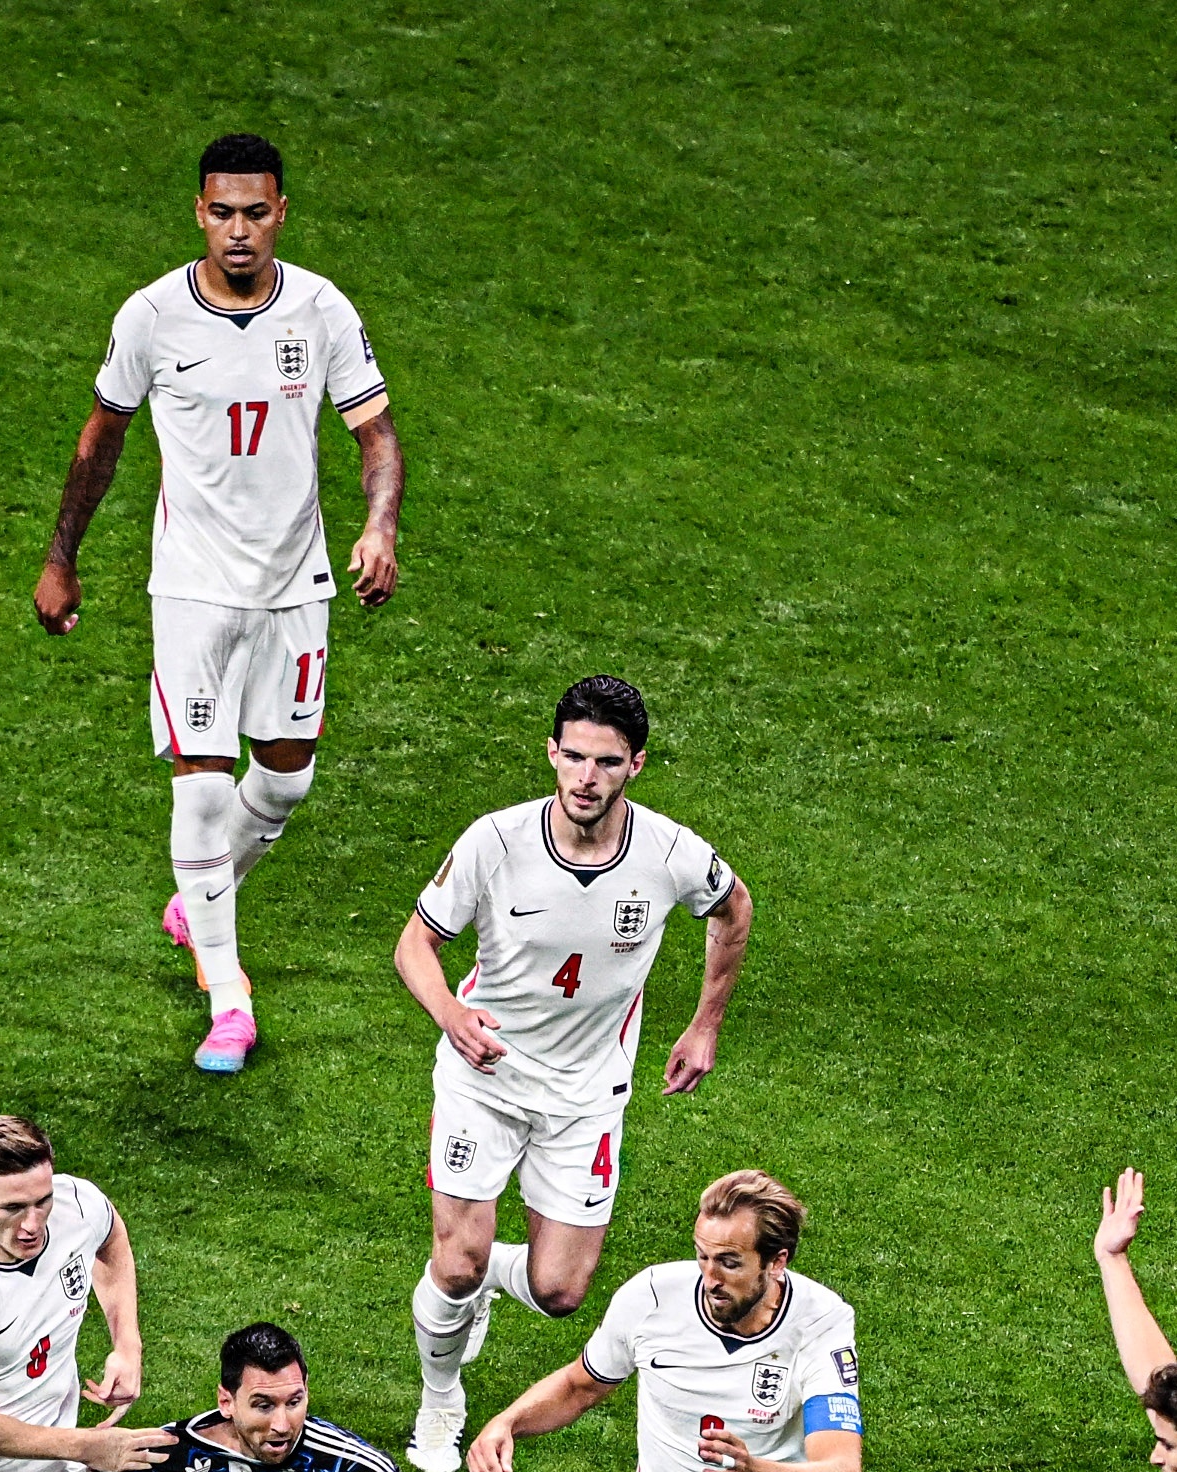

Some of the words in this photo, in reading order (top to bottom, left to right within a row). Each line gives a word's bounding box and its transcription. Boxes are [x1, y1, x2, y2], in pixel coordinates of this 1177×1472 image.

[227, 401, 269, 456] 17
[552, 953, 583, 999] 4
[591, 1132, 612, 1188] 4
